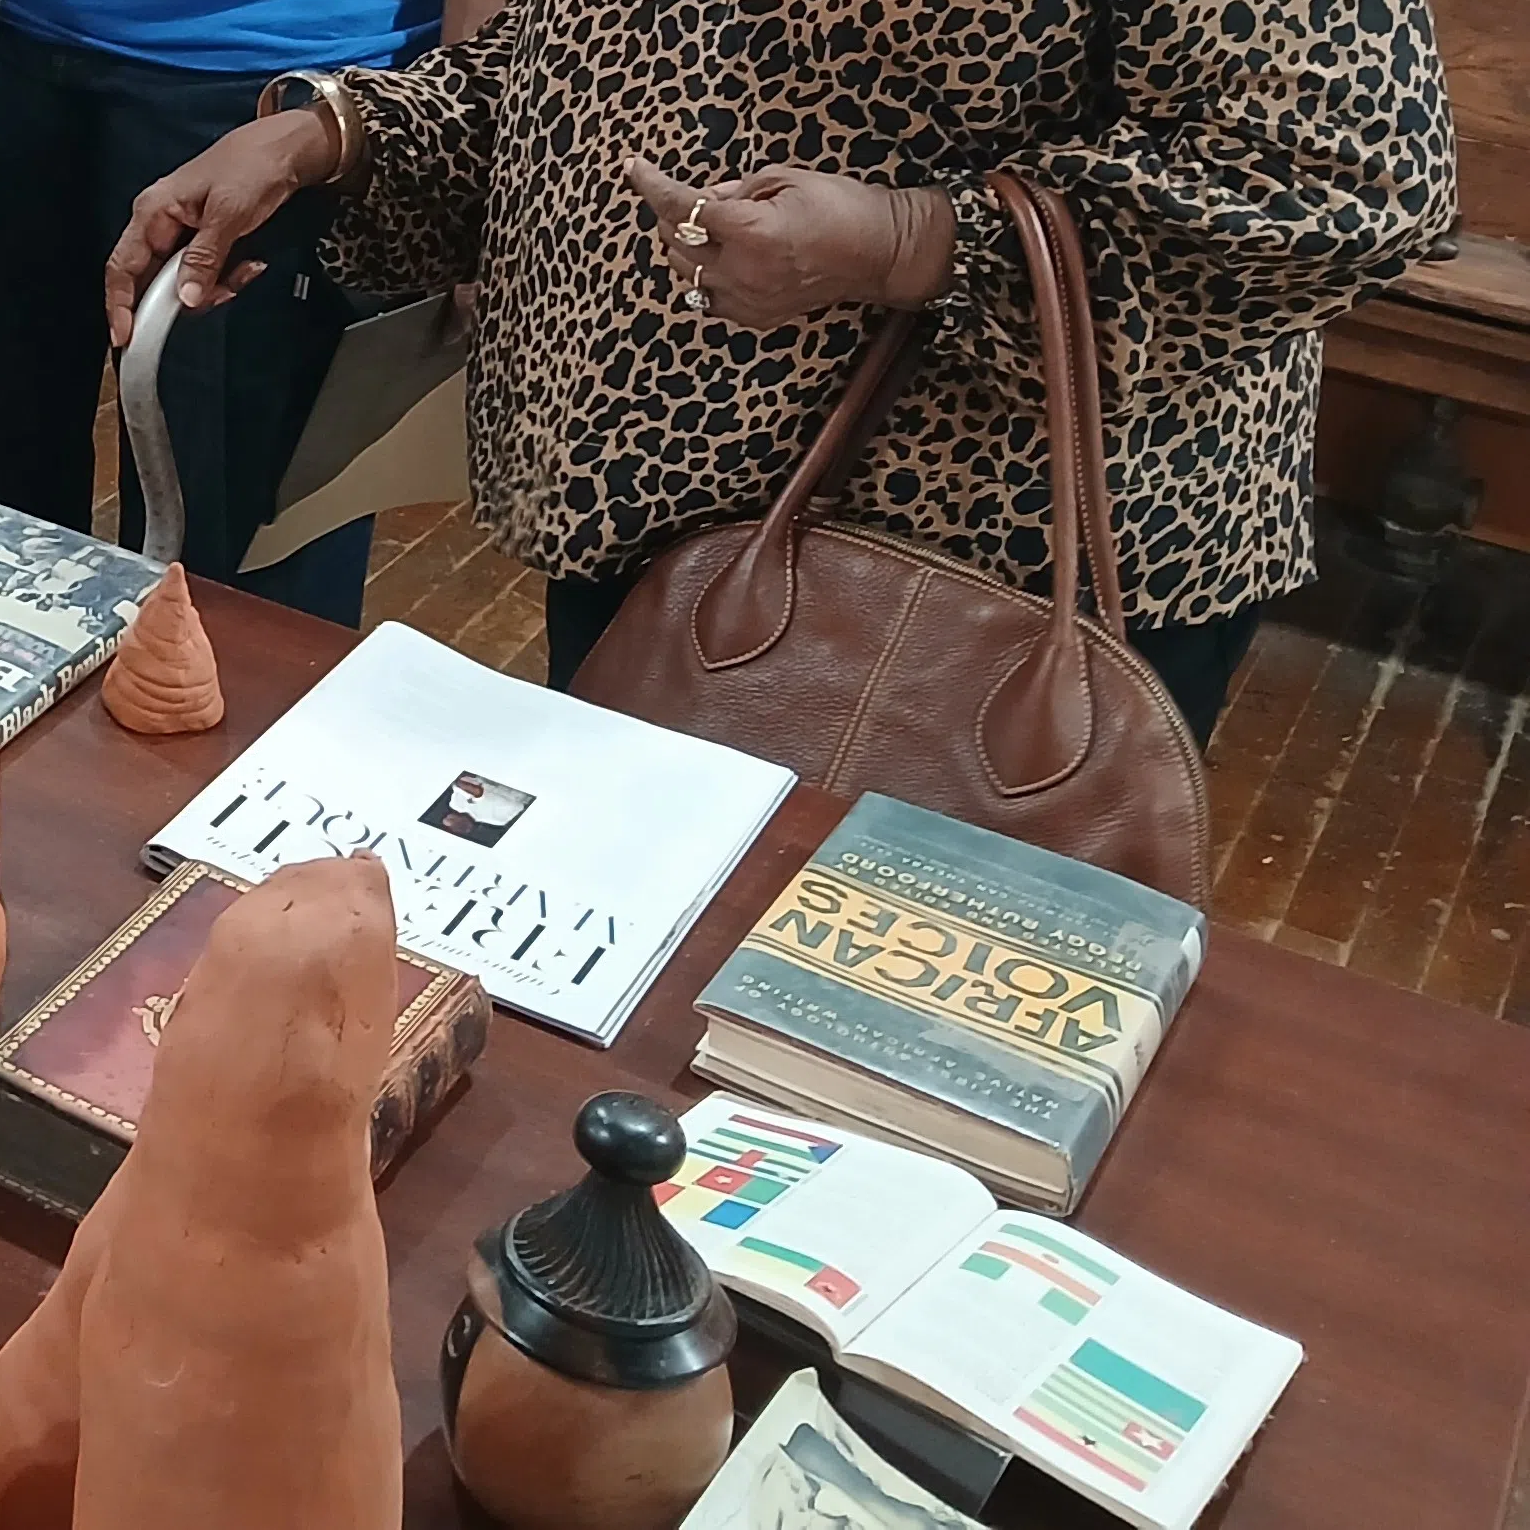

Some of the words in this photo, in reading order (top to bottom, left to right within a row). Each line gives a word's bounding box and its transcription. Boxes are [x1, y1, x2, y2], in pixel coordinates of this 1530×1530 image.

[841, 852, 1040, 931] RUTHERFOORD
[768, 908, 1119, 1054] AFRICAN
[796, 878, 1122, 1033] VOICES
[1049, 929, 1142, 972] PEGGY
[856, 1023, 958, 1069] AFRICAN
